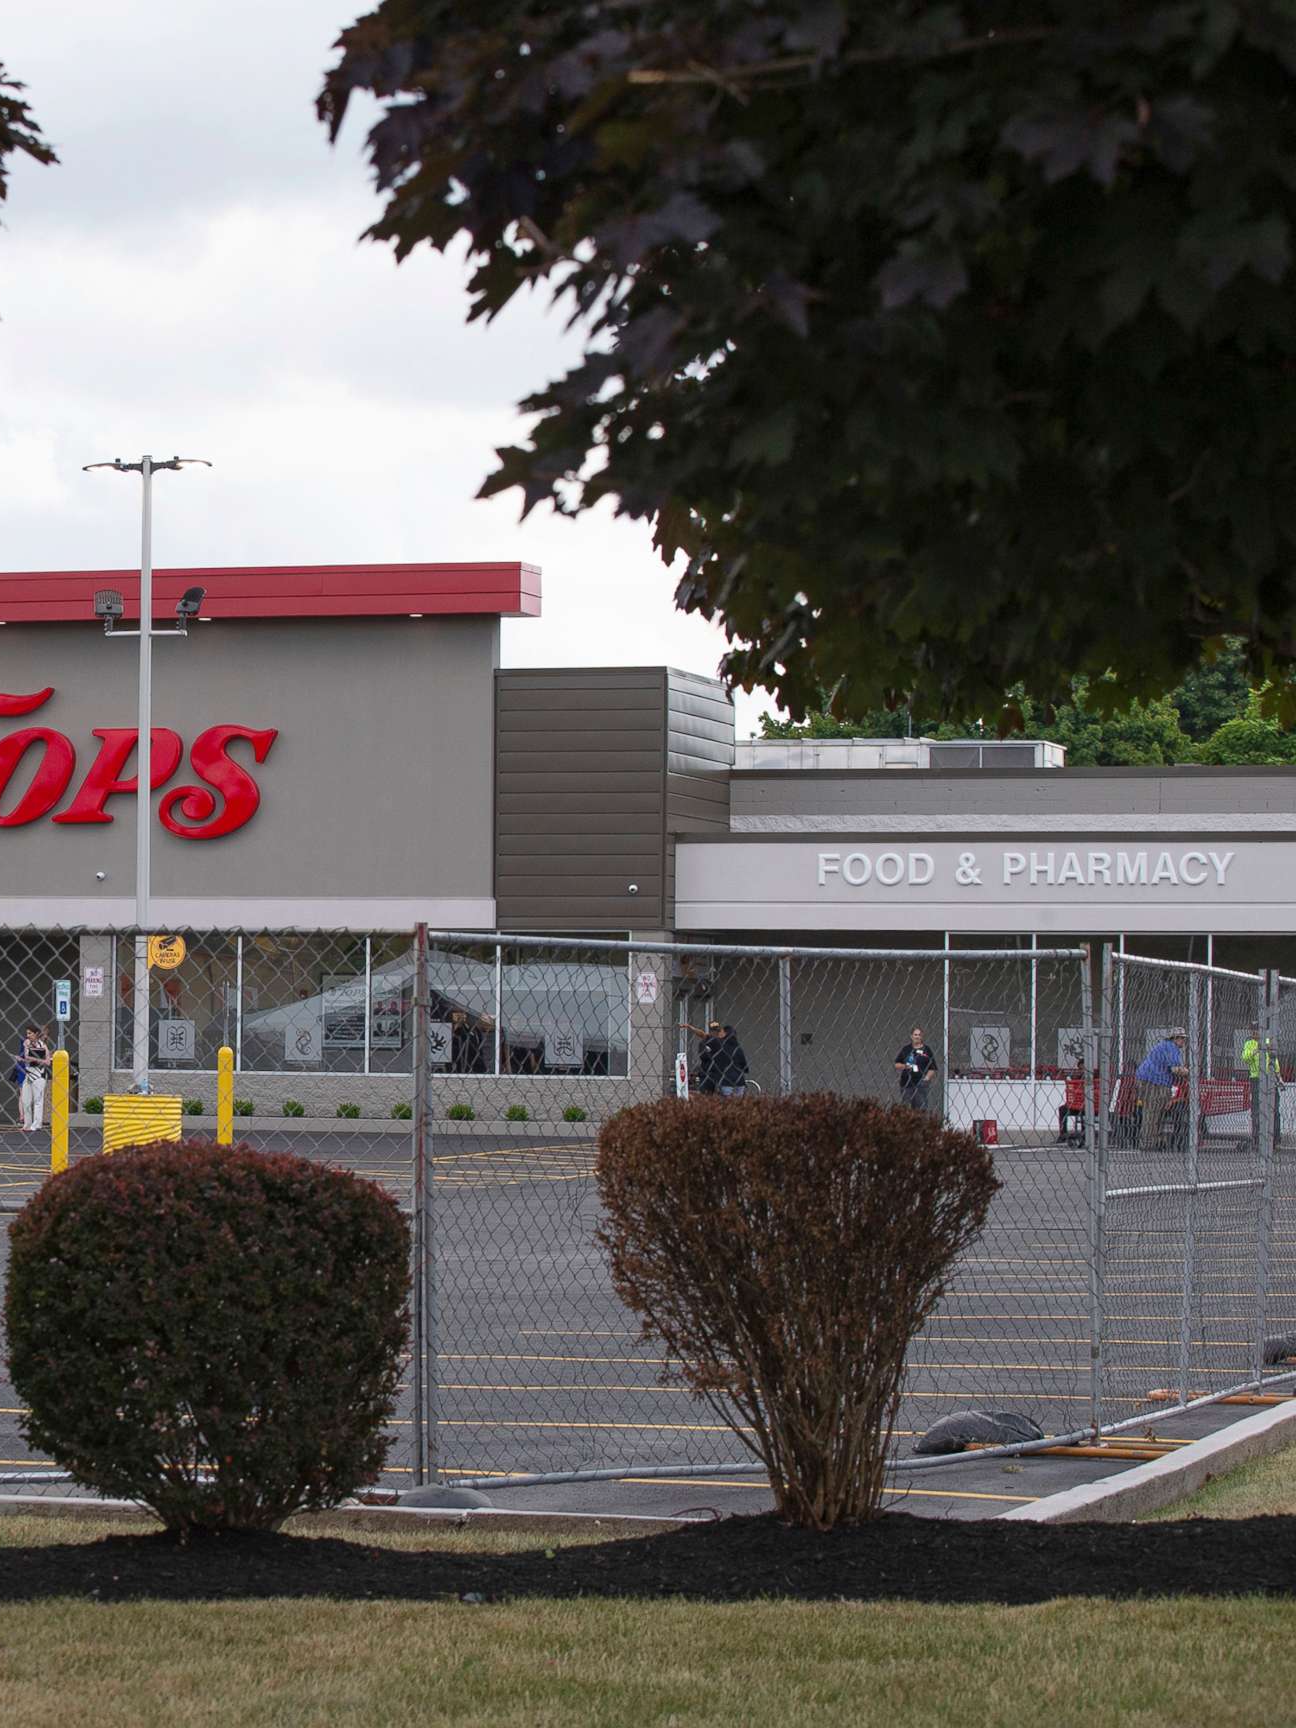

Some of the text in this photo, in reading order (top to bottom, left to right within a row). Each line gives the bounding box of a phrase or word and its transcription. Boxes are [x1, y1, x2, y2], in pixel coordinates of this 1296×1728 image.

[817, 852, 1235, 886] FOOD & PHARMACY
